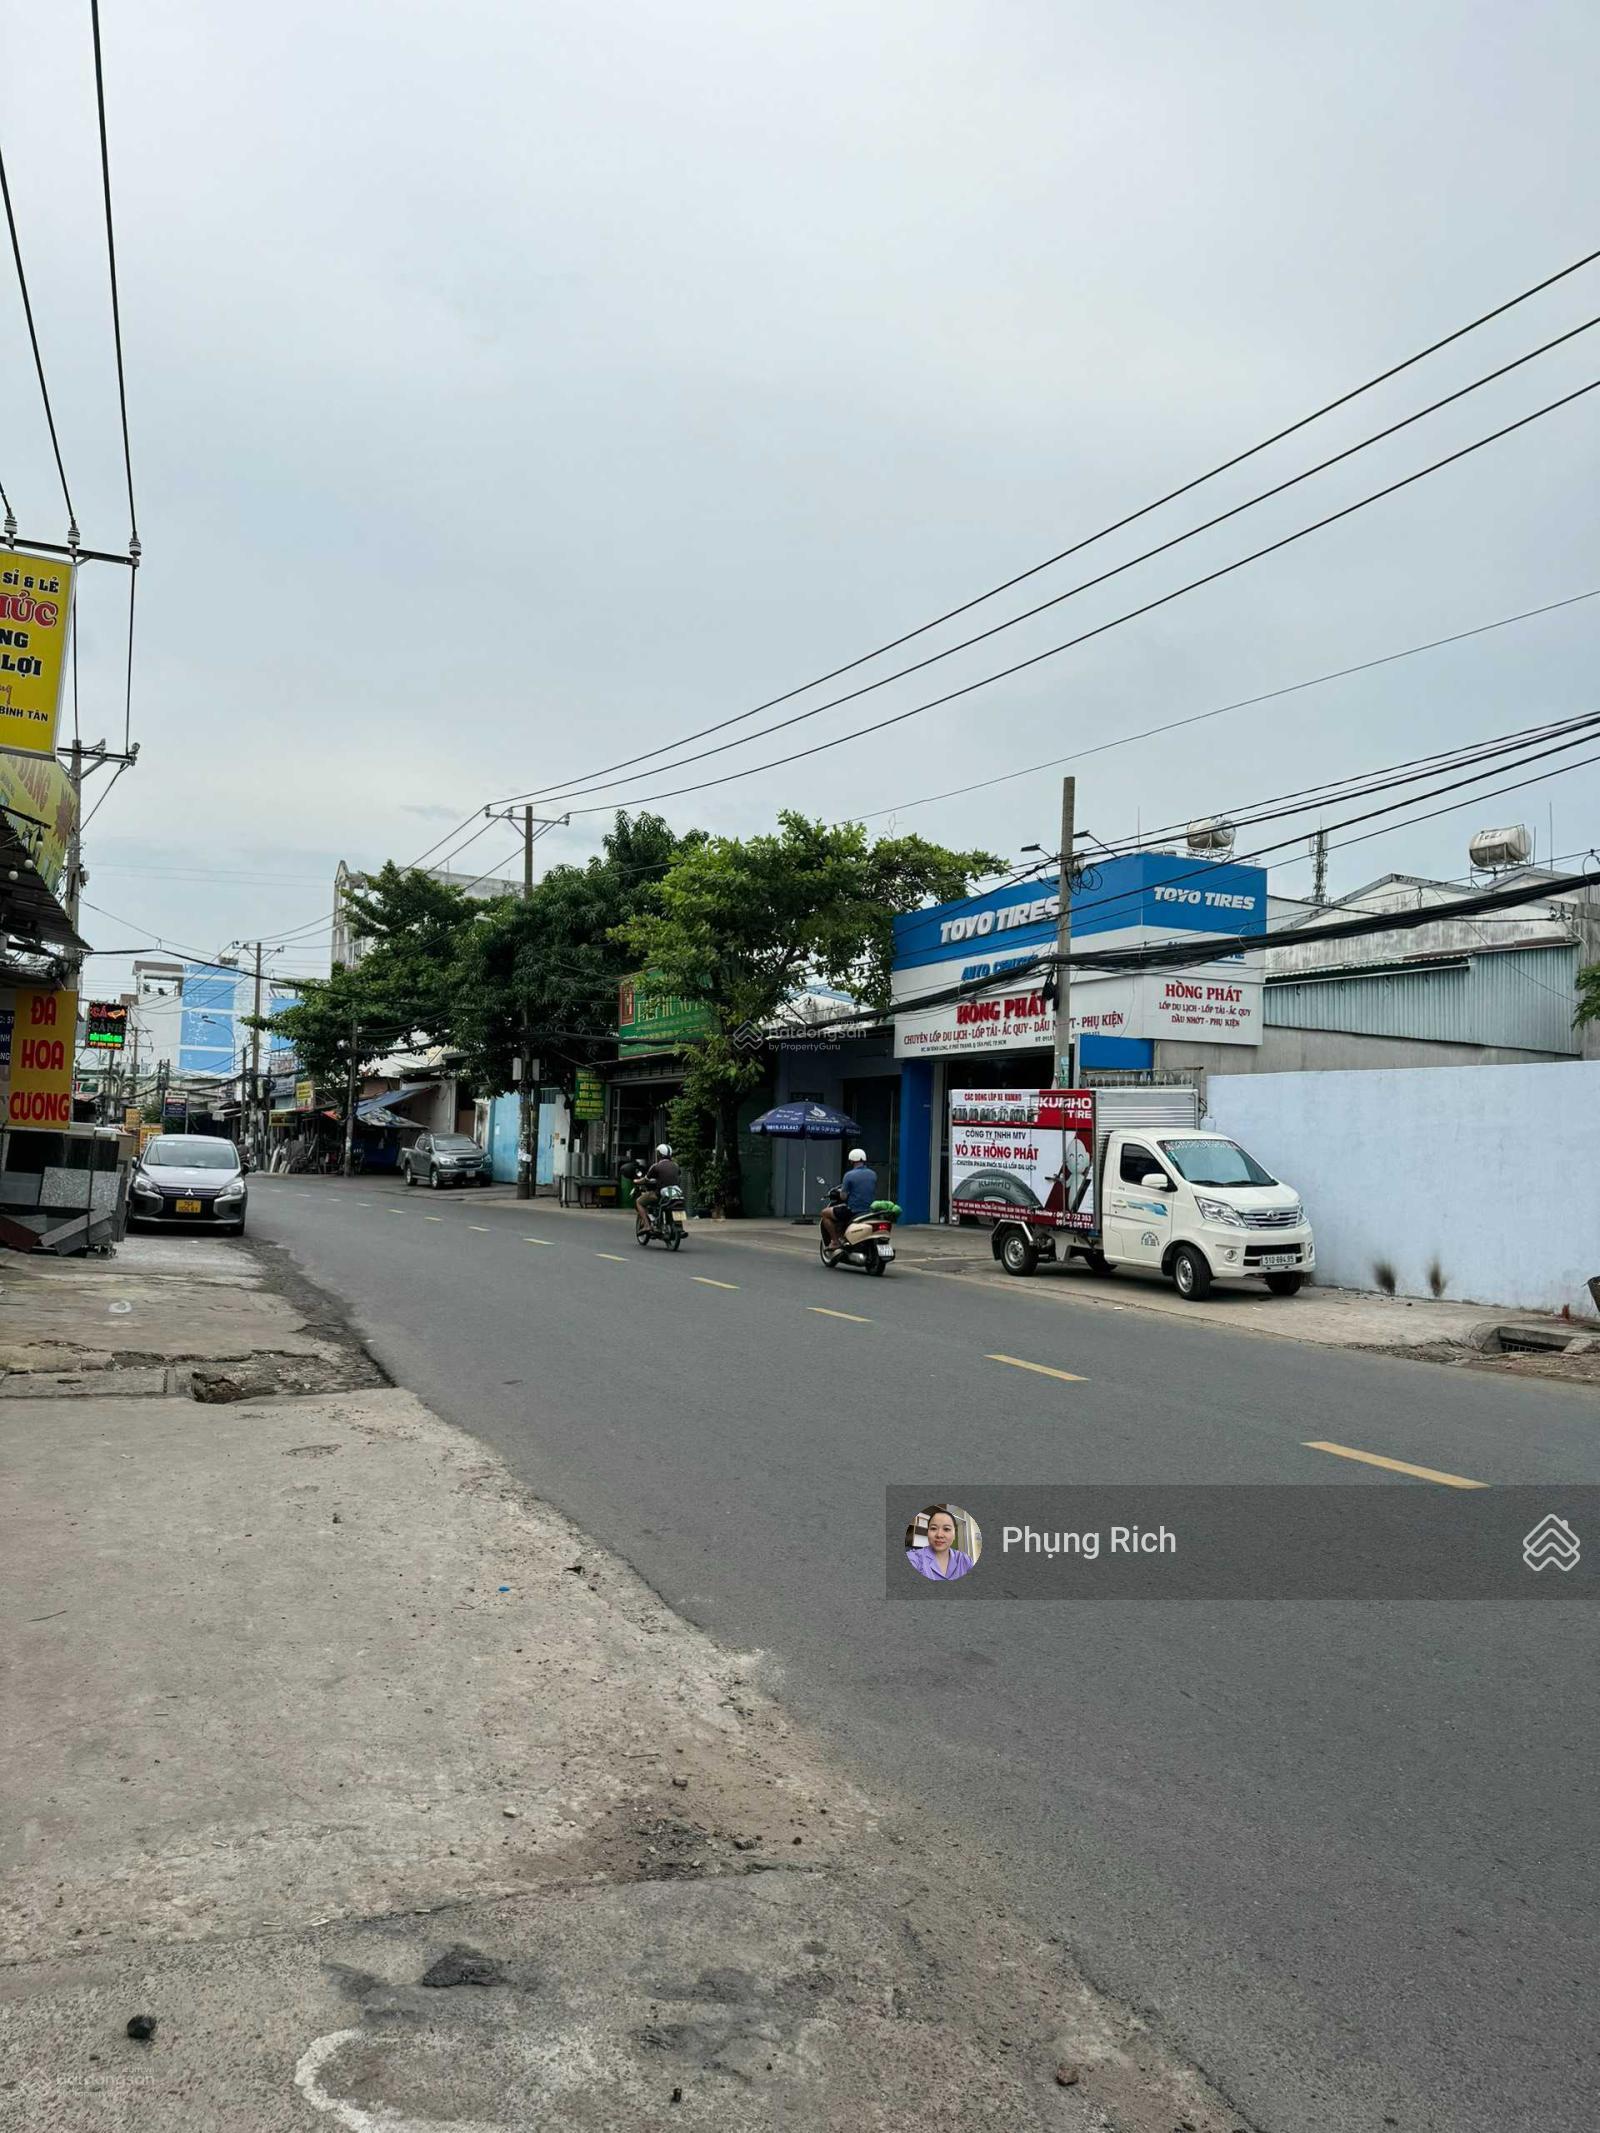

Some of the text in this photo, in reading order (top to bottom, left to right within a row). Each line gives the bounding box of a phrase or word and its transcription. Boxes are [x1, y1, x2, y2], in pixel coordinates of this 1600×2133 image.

[24, 576, 34, 588] &
[1, 654, 42, 677] LỢI
[28, 709, 49, 722] TÂN
[1154, 886, 1256, 911] TOYO TIRES
[940, 895, 1060, 944] TOYO TIRES
[961, 963, 991, 981] AUTO
[1165, 980, 1243, 1002] HỒNG PHÁT
[956, 991, 1048, 1025] HỒNG PHÁT
[1013, 1023, 1029, 1036] QUY
[1081, 1015, 1100, 1030] PHỤ
[1102, 1010, 1124, 1028] KIỆN
[21, 1039, 65, 1070] HOA
[1040, 1097, 1092, 1109] KUMHO
[965, 1128, 984, 1138] CÔNG
[994, 1131, 1012, 1139] TNHH
[1012, 1132, 1027, 1140] MTV
[955, 1140, 1039, 1161] VỎ XE HỒNG PHÁT
